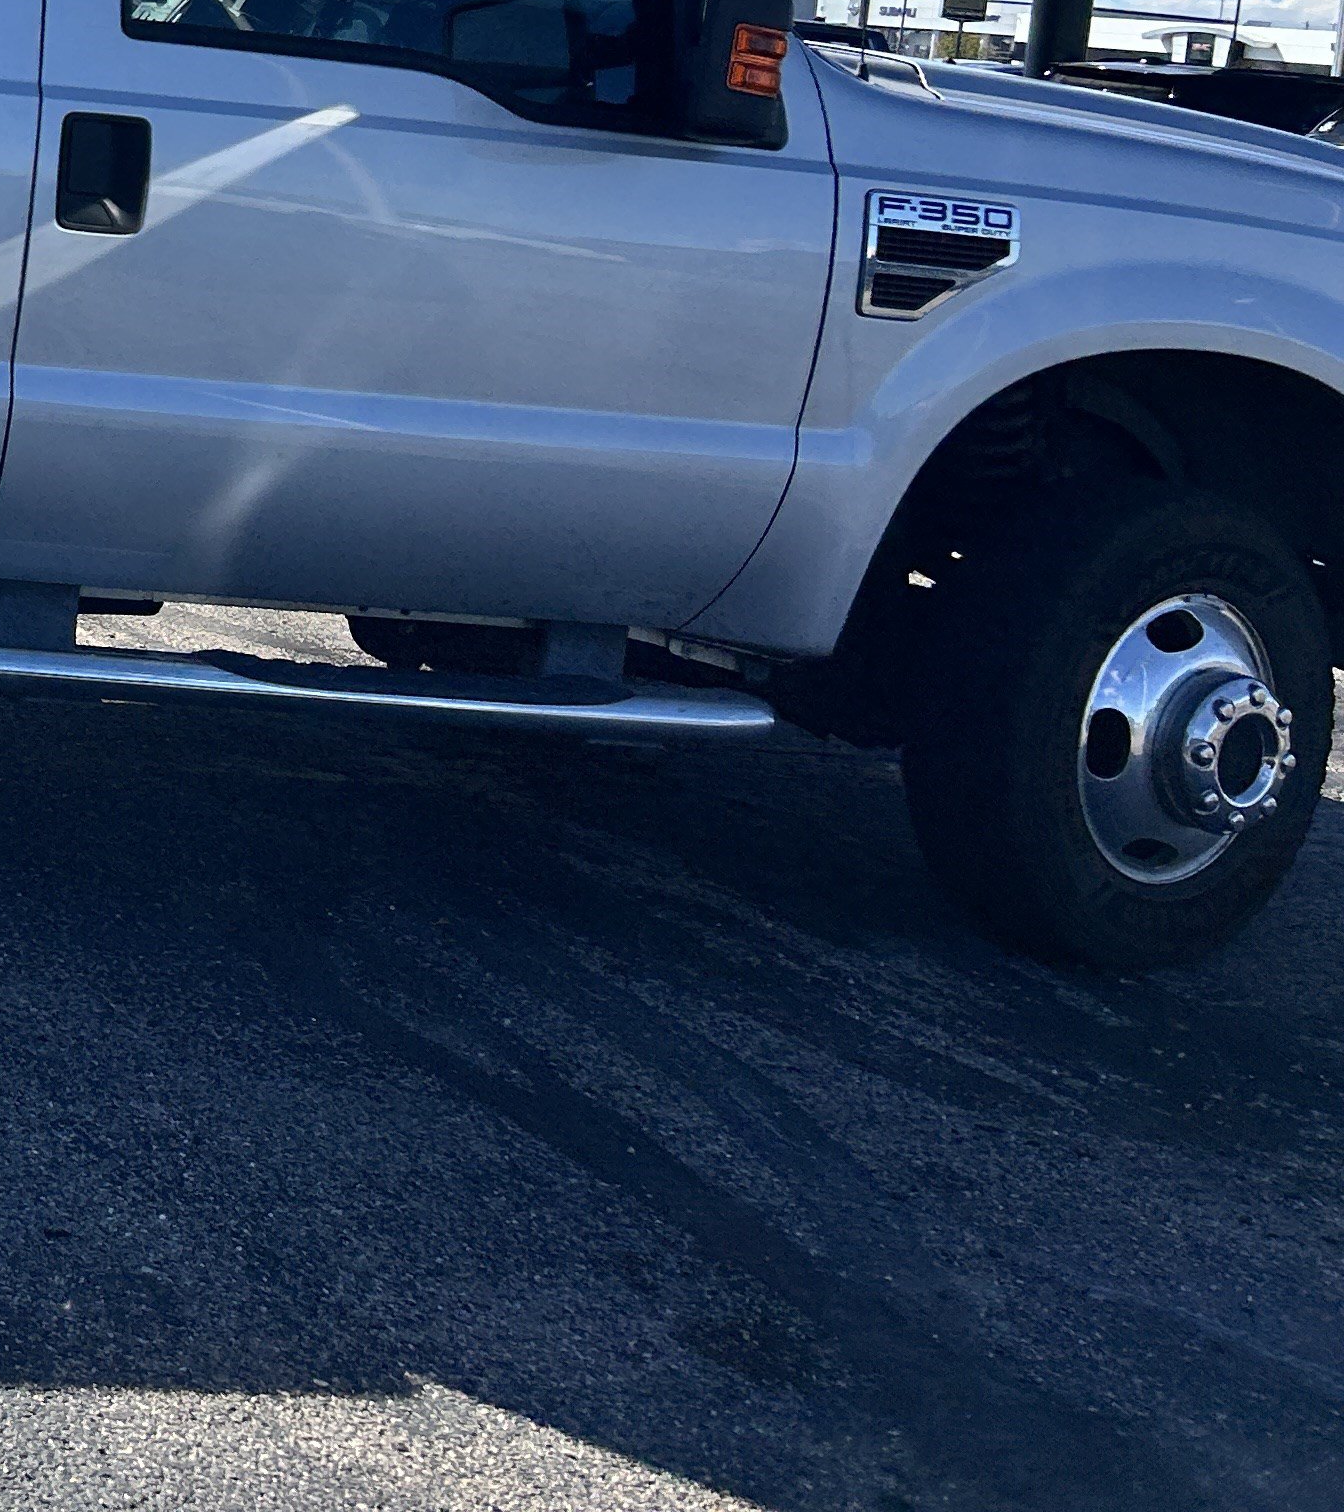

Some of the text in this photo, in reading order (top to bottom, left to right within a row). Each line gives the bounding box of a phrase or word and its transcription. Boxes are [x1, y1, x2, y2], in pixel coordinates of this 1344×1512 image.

[878, 196, 1013, 230] F-350
[941, 224, 1012, 237] SUPER DUTY
